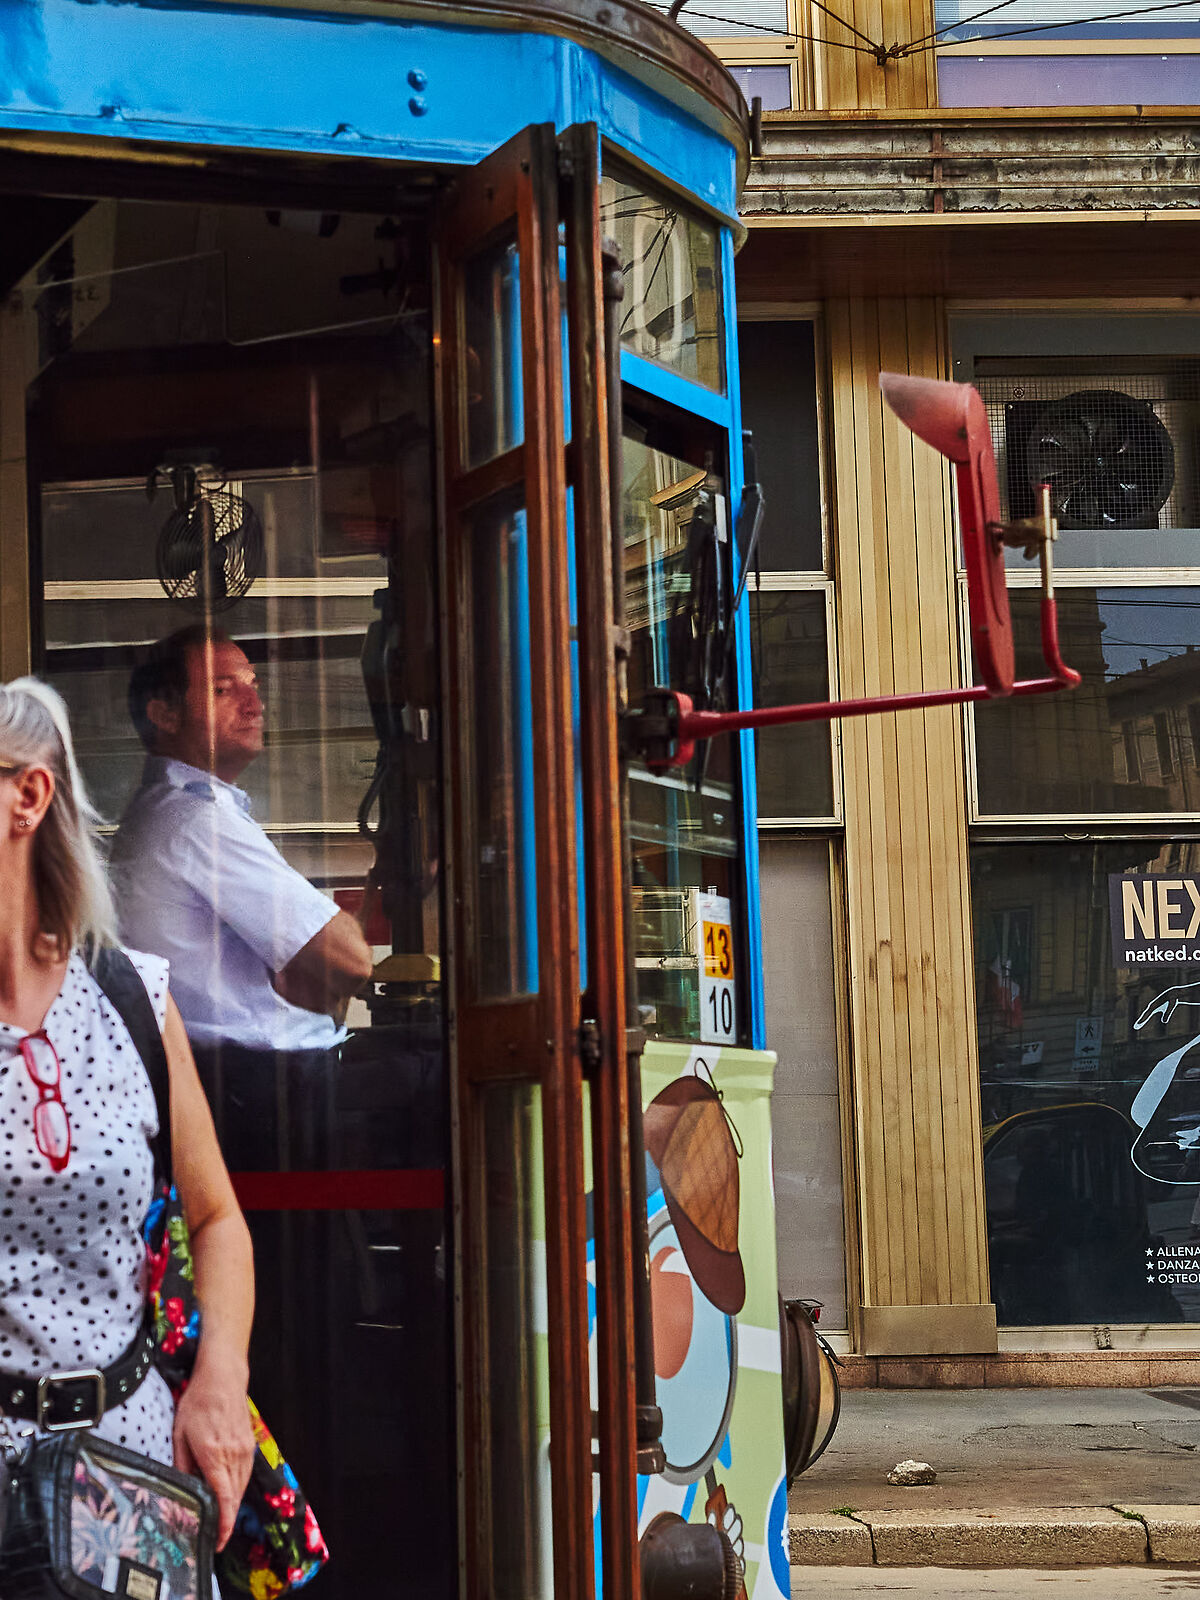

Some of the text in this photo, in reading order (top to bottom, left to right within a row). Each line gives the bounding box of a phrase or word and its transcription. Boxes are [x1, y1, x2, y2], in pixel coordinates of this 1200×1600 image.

[706, 926, 731, 975] 13
[709, 985, 733, 1035] 10
[1156, 1246, 1200, 1257] ALLENA
[1157, 1260, 1200, 1270] DANZA
[1158, 1273, 1200, 1284] OSTEO
